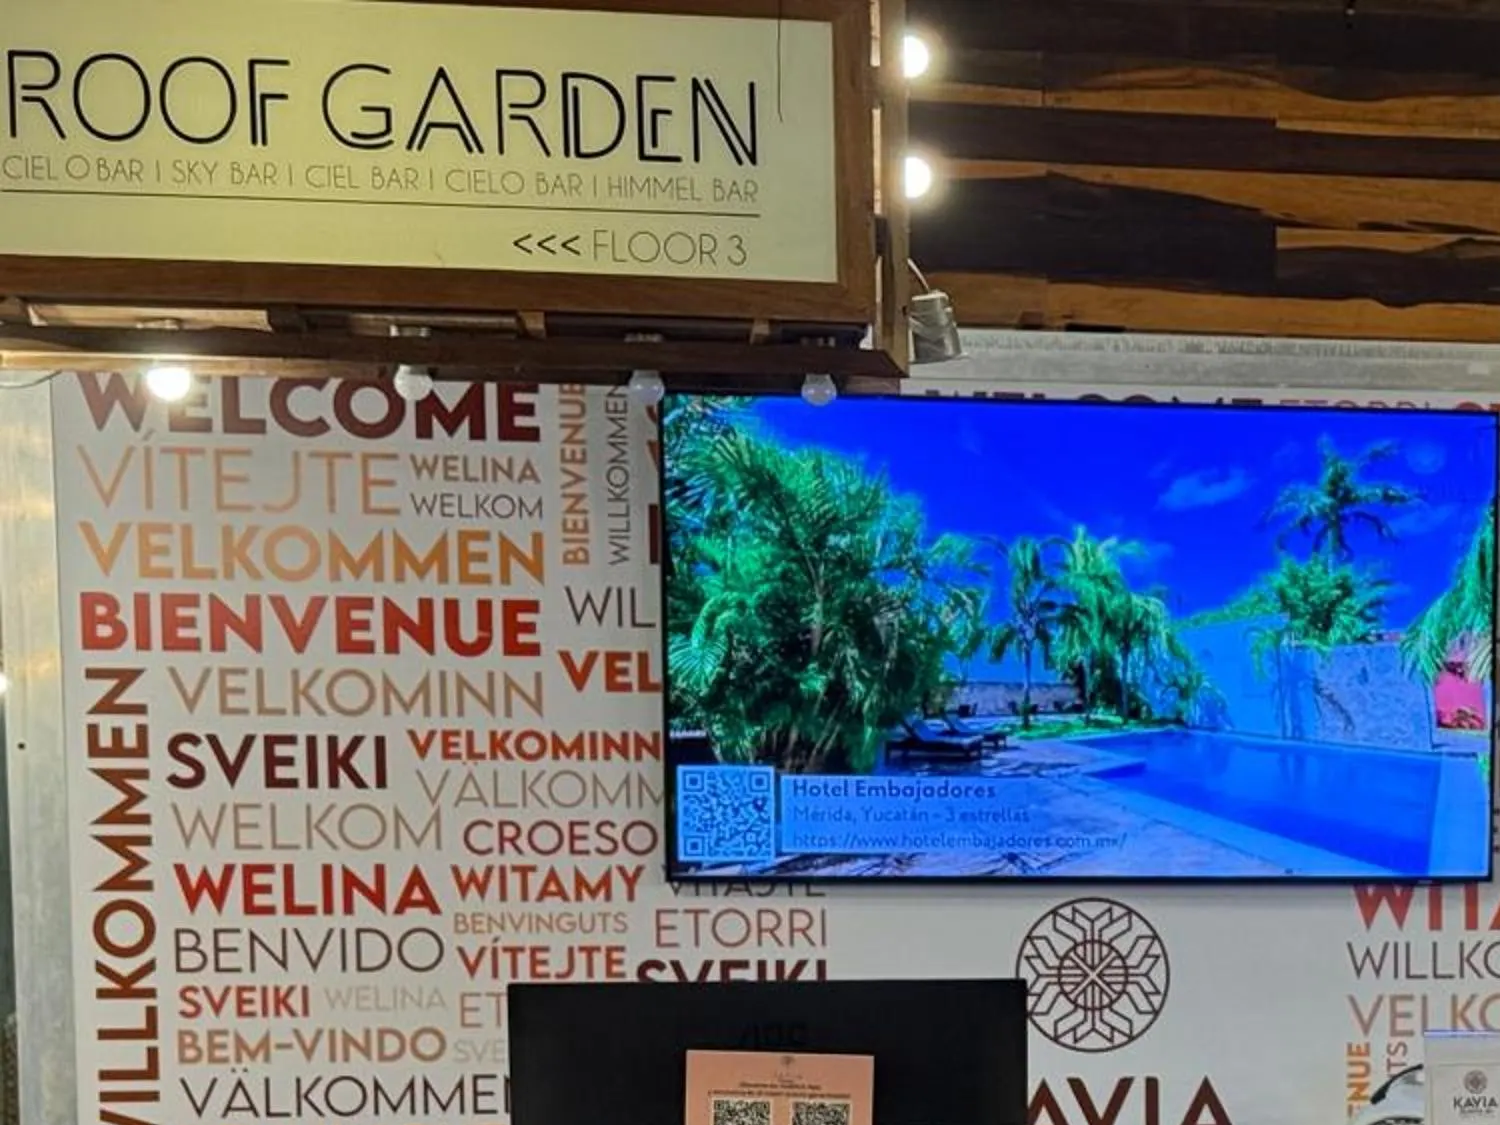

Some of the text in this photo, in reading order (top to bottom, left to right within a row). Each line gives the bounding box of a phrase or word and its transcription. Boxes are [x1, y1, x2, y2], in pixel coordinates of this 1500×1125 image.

[6, 50, 759, 167] ROOF GARDEN
[172, 160, 218, 185] SKY
[231, 162, 278, 186] BAR
[305, 165, 359, 189] CIEL
[372, 166, 419, 190] BAR
[445, 169, 525, 195] CIELO
[536, 172, 583, 197] BAR
[608, 175, 702, 202] HIMMEL
[713, 179, 759, 202] BAR
[593, 230, 747, 266] FLOOR 3
[77, 429, 400, 515] VÍTEJTE
[410, 453, 541, 484] WELINA
[410, 493, 543, 519] WELKOM
[78, 521, 545, 586] VELKOMMEN
[80, 591, 541, 658] BIENVENUE
[565, 585, 657, 629] WIL
[166, 666, 543, 718] VELKOMINN
[557, 650, 663, 694] VEL
[165, 732, 388, 789] SVEIKI
[407, 729, 661, 761] VELKOMINN
[415, 761, 664, 808] VÄLKOMM
[793, 779, 997, 803] Hotel Embajadores
[170, 802, 442, 850] WELKOM
[958, 806, 1031, 824] estrellas
[463, 819, 659, 856] CROESO
[173, 863, 443, 917] WELINA
[450, 864, 646, 903] WITAMY
[452, 911, 629, 934] BENVINGUTS
[655, 907, 827, 949] ETORRI
[175, 926, 445, 974] BENVIDO
[456, 935, 627, 979] VÍTEJTE
[178, 985, 310, 1019] SVEIKI
[323, 986, 447, 1012] WELINA
[177, 1026, 447, 1065] BEM-VINDO
[179, 1067, 510, 1119] VÄLKOMME
